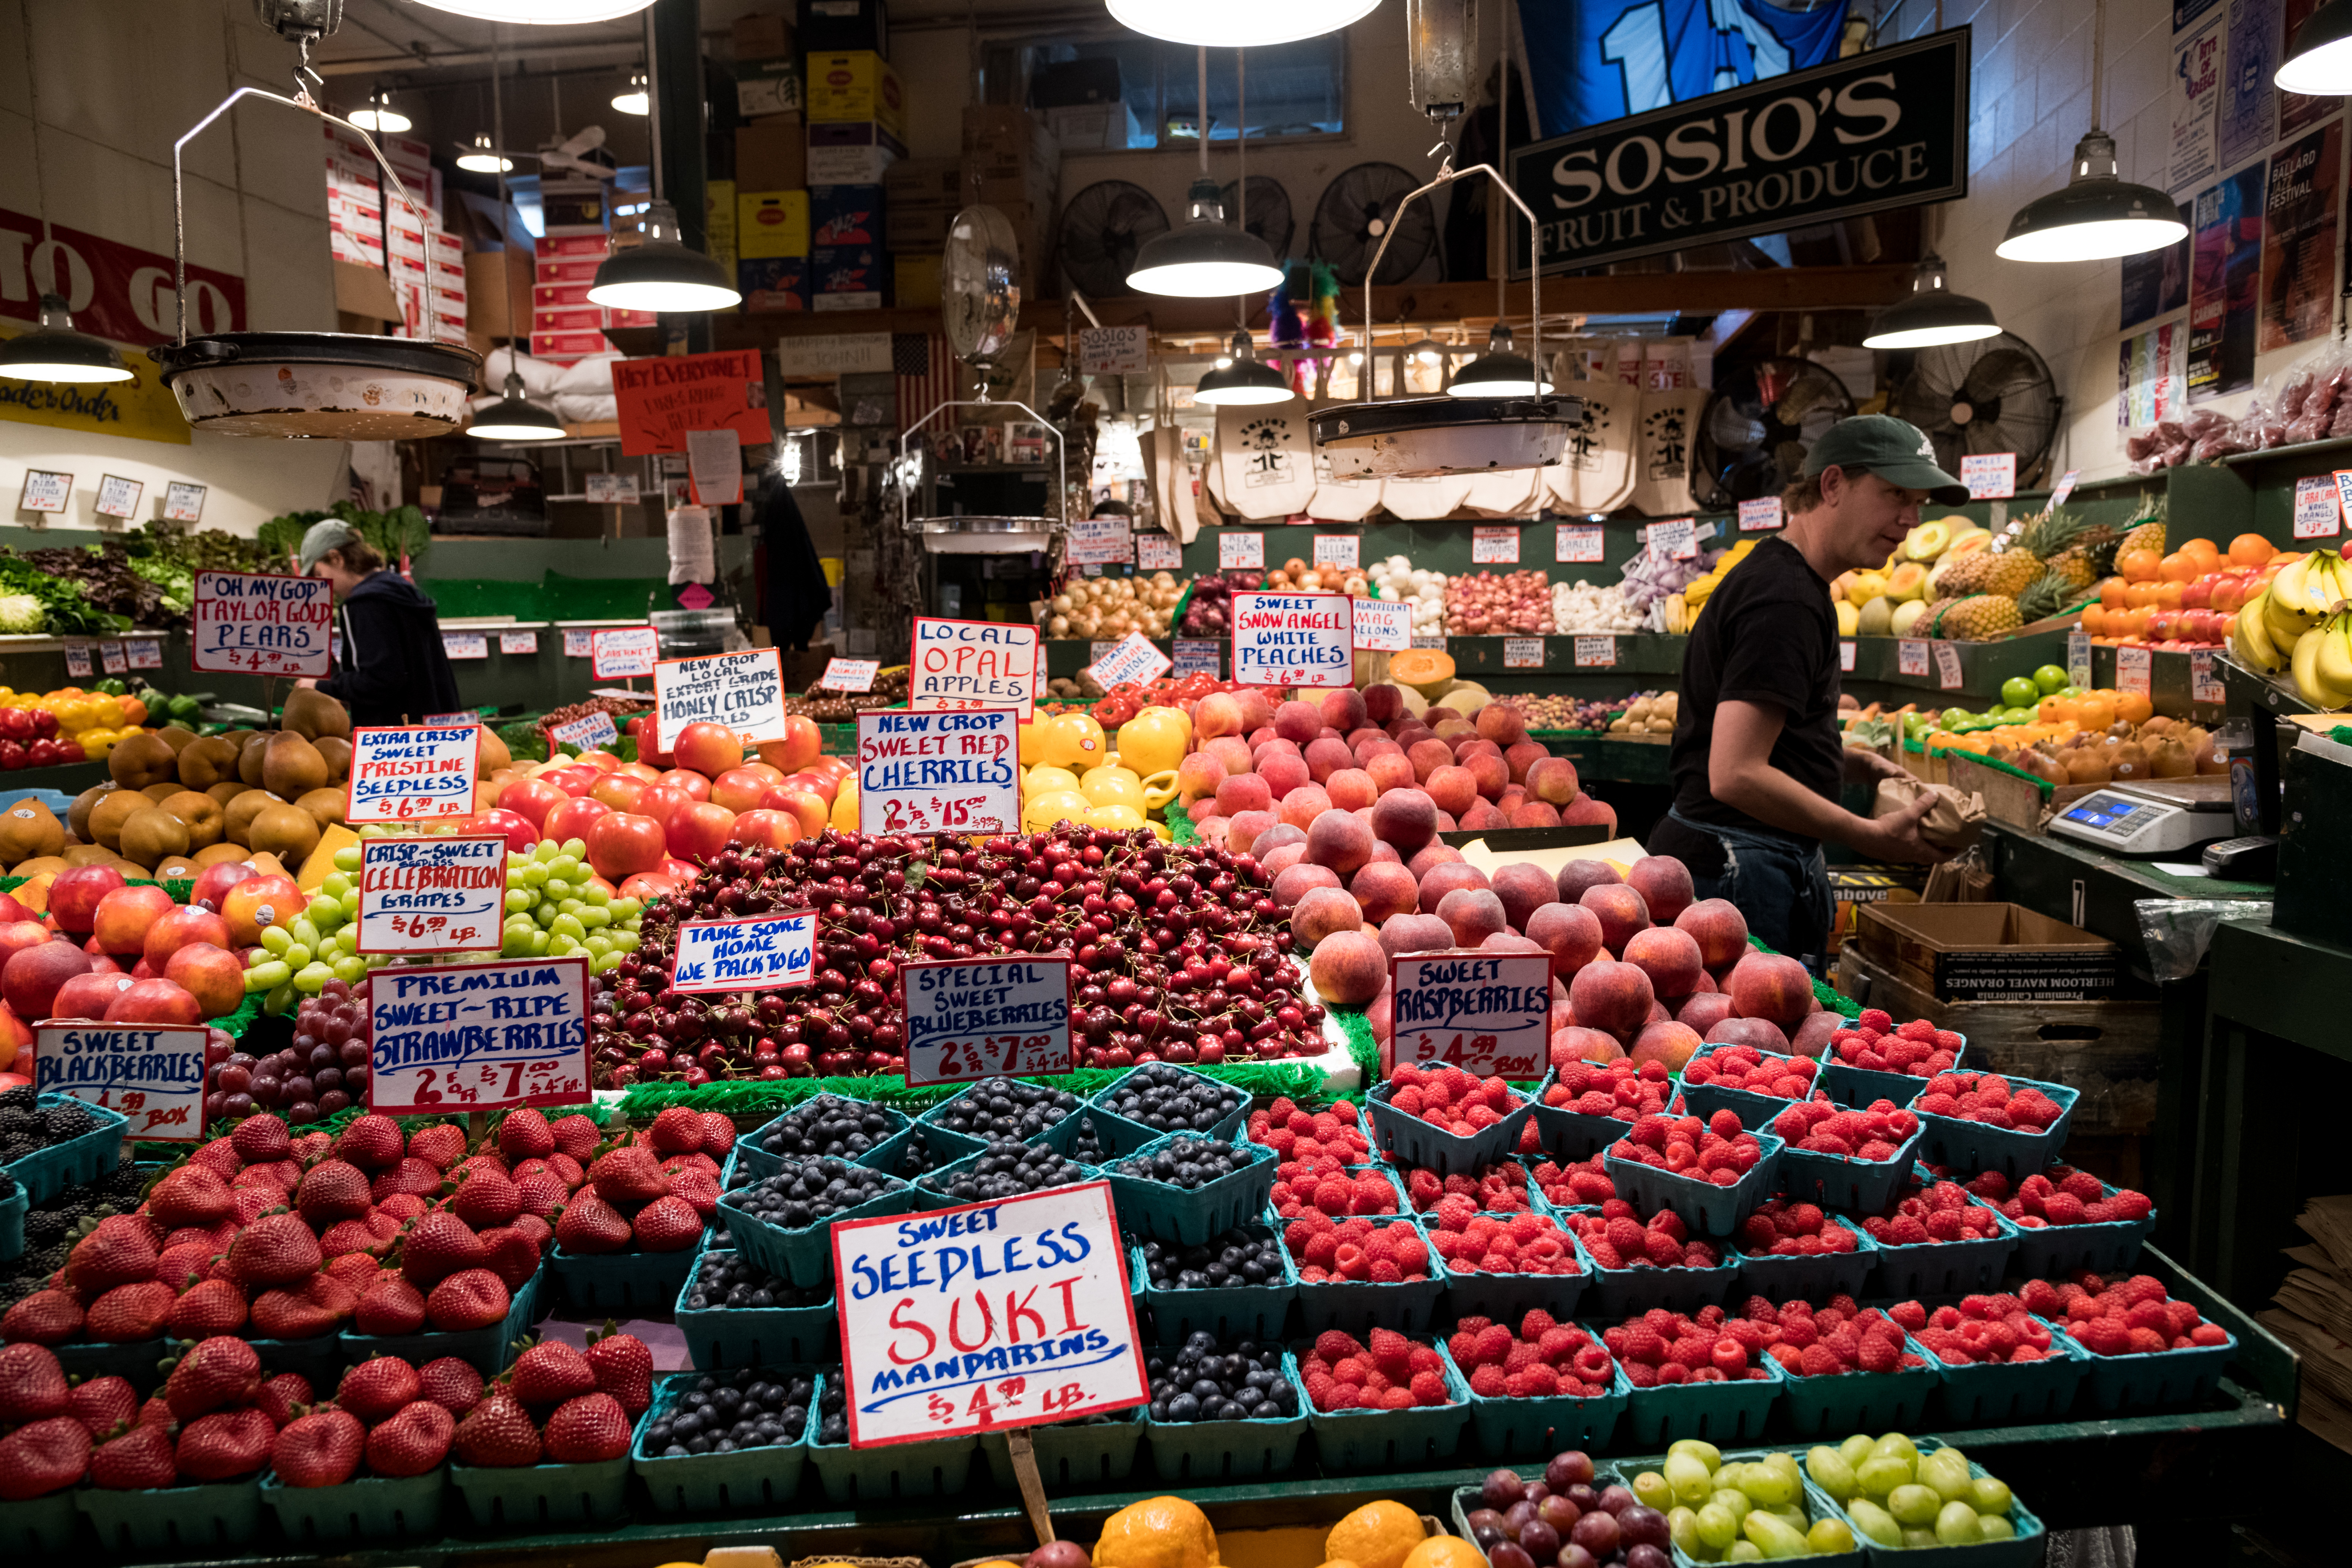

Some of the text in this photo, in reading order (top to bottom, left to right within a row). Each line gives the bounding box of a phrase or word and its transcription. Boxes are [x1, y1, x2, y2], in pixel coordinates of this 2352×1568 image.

[2199, 35, 2217, 62] BITE
[1552, 72, 1902, 210] SOSIO'S
[2272, 150, 2316, 183] BALLARD
[1537, 141, 1929, 256] FRUIT & PRODUCE
[2269, 180, 2312, 211] FESTIVAL
[2272, 175, 2294, 196] JAZZ
[0, 228, 231, 338] TO GO
[2298, 492, 2319, 507] CARA
[2308, 502, 2328, 511] NAVEL
[2297, 509, 2333, 522] ORANGES
[1220, 544, 1260, 552] ONIONS
[1317, 544, 1354, 553] YELLOW
[1558, 538, 1598, 552] GARLIC
[249, 579, 279, 601] MY
[1254, 597, 1317, 609] SWEET
[196, 597, 332, 631] TAYLOR GOLD
[1355, 601, 1408, 612] AGNIFICENT
[1355, 612, 1393, 626] MAG
[1238, 610, 1347, 631] SNOW ANGEL
[215, 624, 310, 648] PEARS
[921, 623, 1031, 645] LOCAL
[1257, 631, 1319, 645] WHITE
[597, 645, 653, 660] CABERNET
[679, 653, 760, 674] NEW CROP
[924, 646, 1031, 679] OPAL
[1097, 641, 1129, 673] JUMBO
[1098, 643, 1144, 683] BEEFSTEAK
[1238, 646, 1344, 665] PEACHES
[691, 667, 745, 682] LOCAL
[1105, 650, 1152, 689] TOMATOES
[666, 669, 779, 700] EXPORT GRADE
[925, 676, 1023, 697] APPLES
[663, 683, 778, 721] HONEY CRISP
[878, 714, 1005, 733] NEW CROP
[361, 728, 474, 747] EXTRA CRISP
[861, 733, 1010, 763] SWEET RED
[371, 744, 440, 761] SWEET
[357, 757, 466, 779] PRISTINE
[863, 758, 1013, 791] CHERRIES
[356, 775, 467, 796] SEEDLESS
[885, 798, 907, 831] 2
[366, 842, 499, 864] CRISP SWEET
[398, 858, 455, 869] SEEDLESS
[364, 858, 504, 895] CELEBRATION
[381, 892, 466, 909] GRAPES
[1833, 888, 1888, 901] above
[449, 926, 481, 945] LB.
[688, 917, 806, 944] TAKE SOME
[713, 936, 778, 960] HOME
[675, 947, 811, 982] WE PACK TO GO
[919, 964, 1045, 991] SPECIAL
[1418, 959, 1503, 987] SWEET
[391, 967, 561, 998] PREMIUM
[1946, 977, 2115, 988] HEIRLOOM NAVEL ORANGES
[934, 986, 1014, 1012] SWEET
[1394, 985, 1551, 1027] RASPBERRIES
[1976, 991, 2084, 1001] Premium California
[375, 993, 571, 1031] SWEET RIPE
[905, 998, 1069, 1049] BLUEBERRIES
[63, 1031, 163, 1055] SWEET
[373, 1017, 588, 1069] STRAWBERRIES
[939, 1042, 962, 1076] 2
[962, 1042, 984, 1072] FOR
[1490, 1053, 1538, 1075] BOX
[35, 1051, 205, 1094] BLACKBERRIES
[414, 1069, 443, 1105] 2
[447, 1071, 477, 1103] FOR
[140, 1104, 192, 1133] BOX
[898, 1203, 1003, 1248] SWEET
[851, 1221, 1091, 1300] SEEDLESS
[887, 1276, 1090, 1365] SUKI
[871, 1328, 1110, 1394] MANDARINS
[1042, 1382, 1097, 1421] LB.
